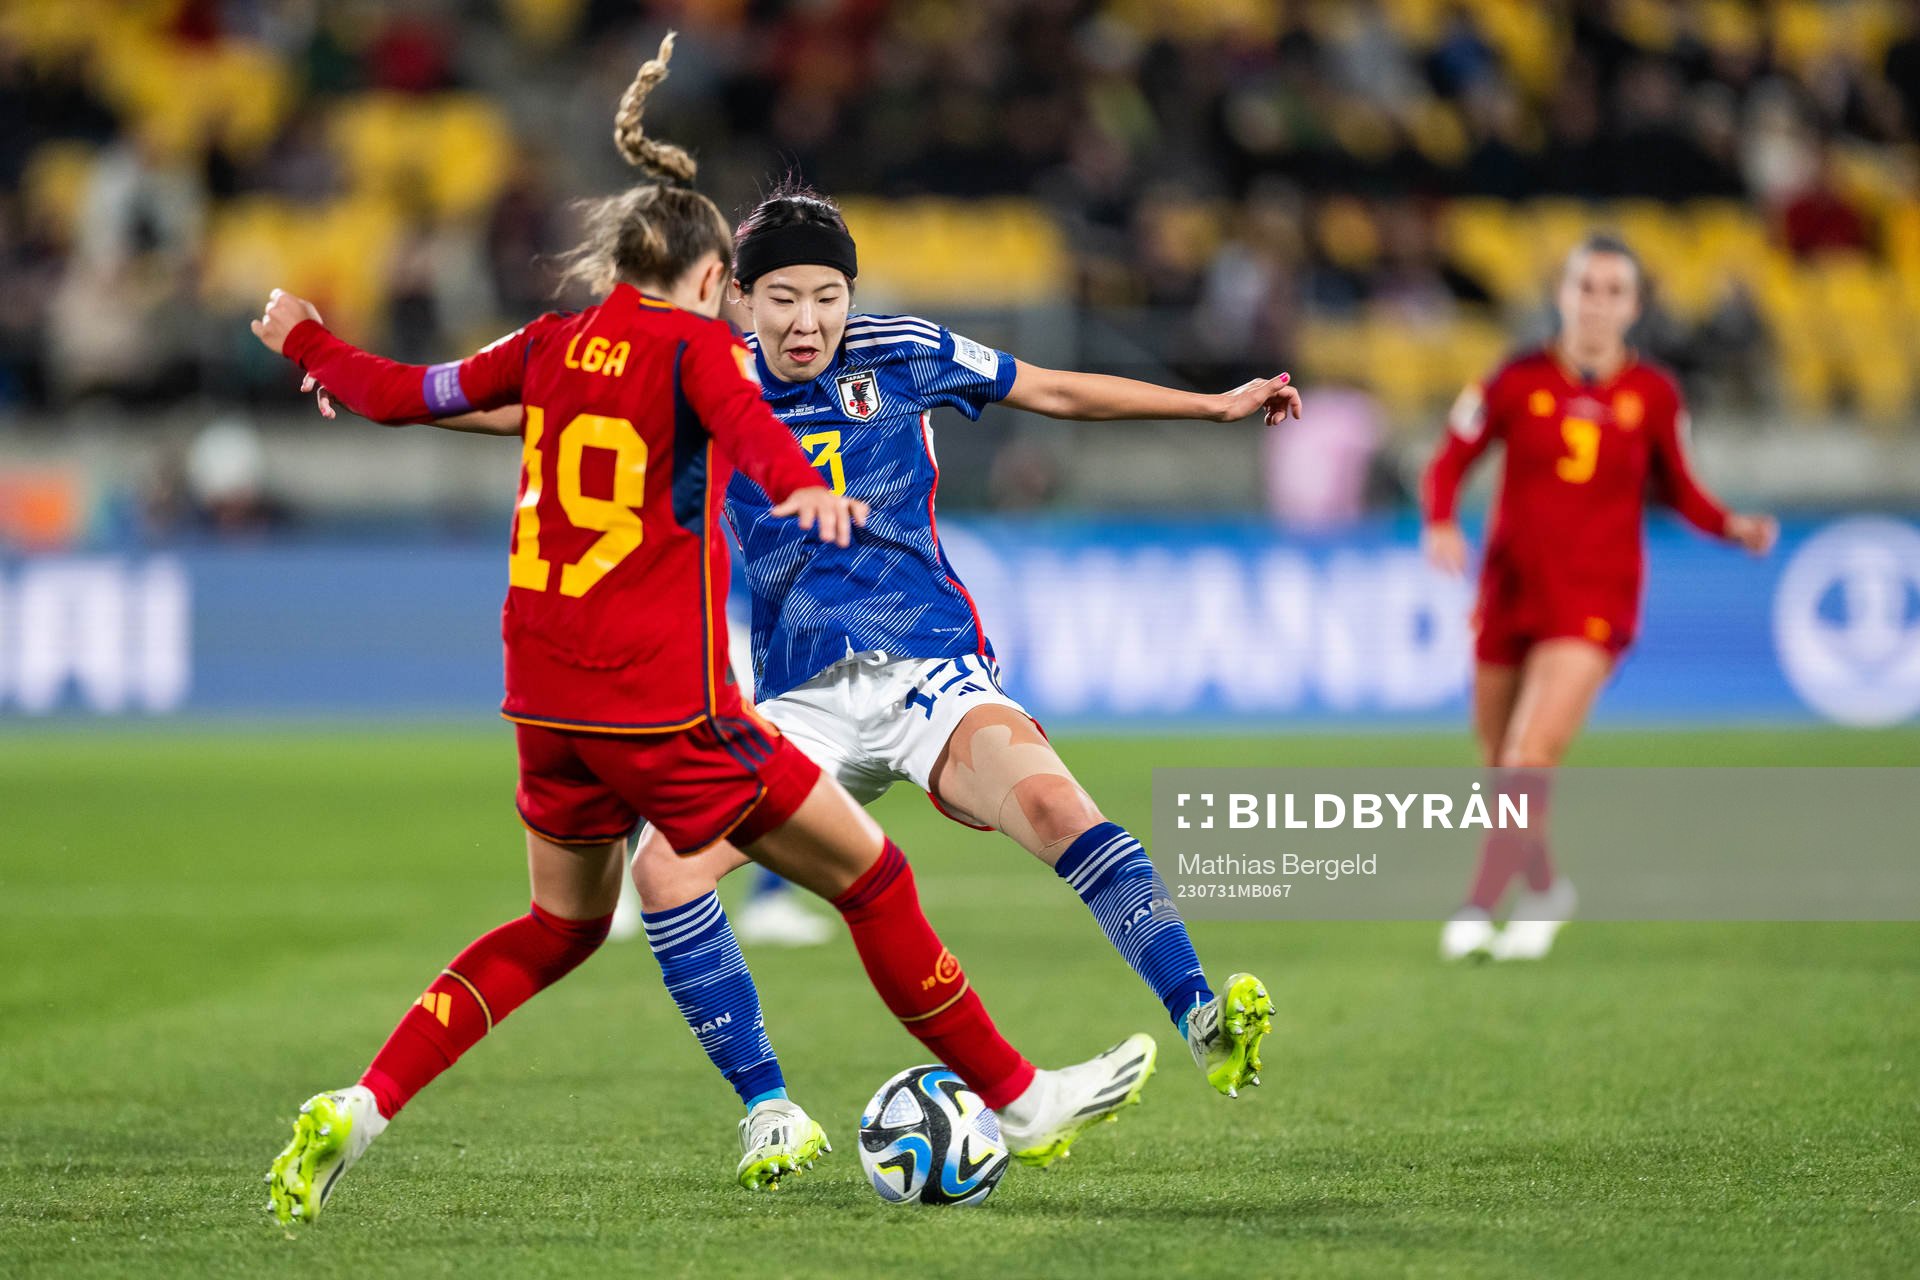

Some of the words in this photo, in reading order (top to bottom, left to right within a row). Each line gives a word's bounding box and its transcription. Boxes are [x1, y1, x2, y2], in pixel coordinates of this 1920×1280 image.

[564, 332, 631, 378] LGA
[845, 374, 866, 382] JAPAN
[801, 430, 847, 497] 3
[1557, 417, 1601, 484] 3
[508, 404, 648, 599] 19
[1018, 548, 1472, 710] WAND
[1124, 898, 1179, 935] JAPA
[690, 1012, 732, 1036] PAN
